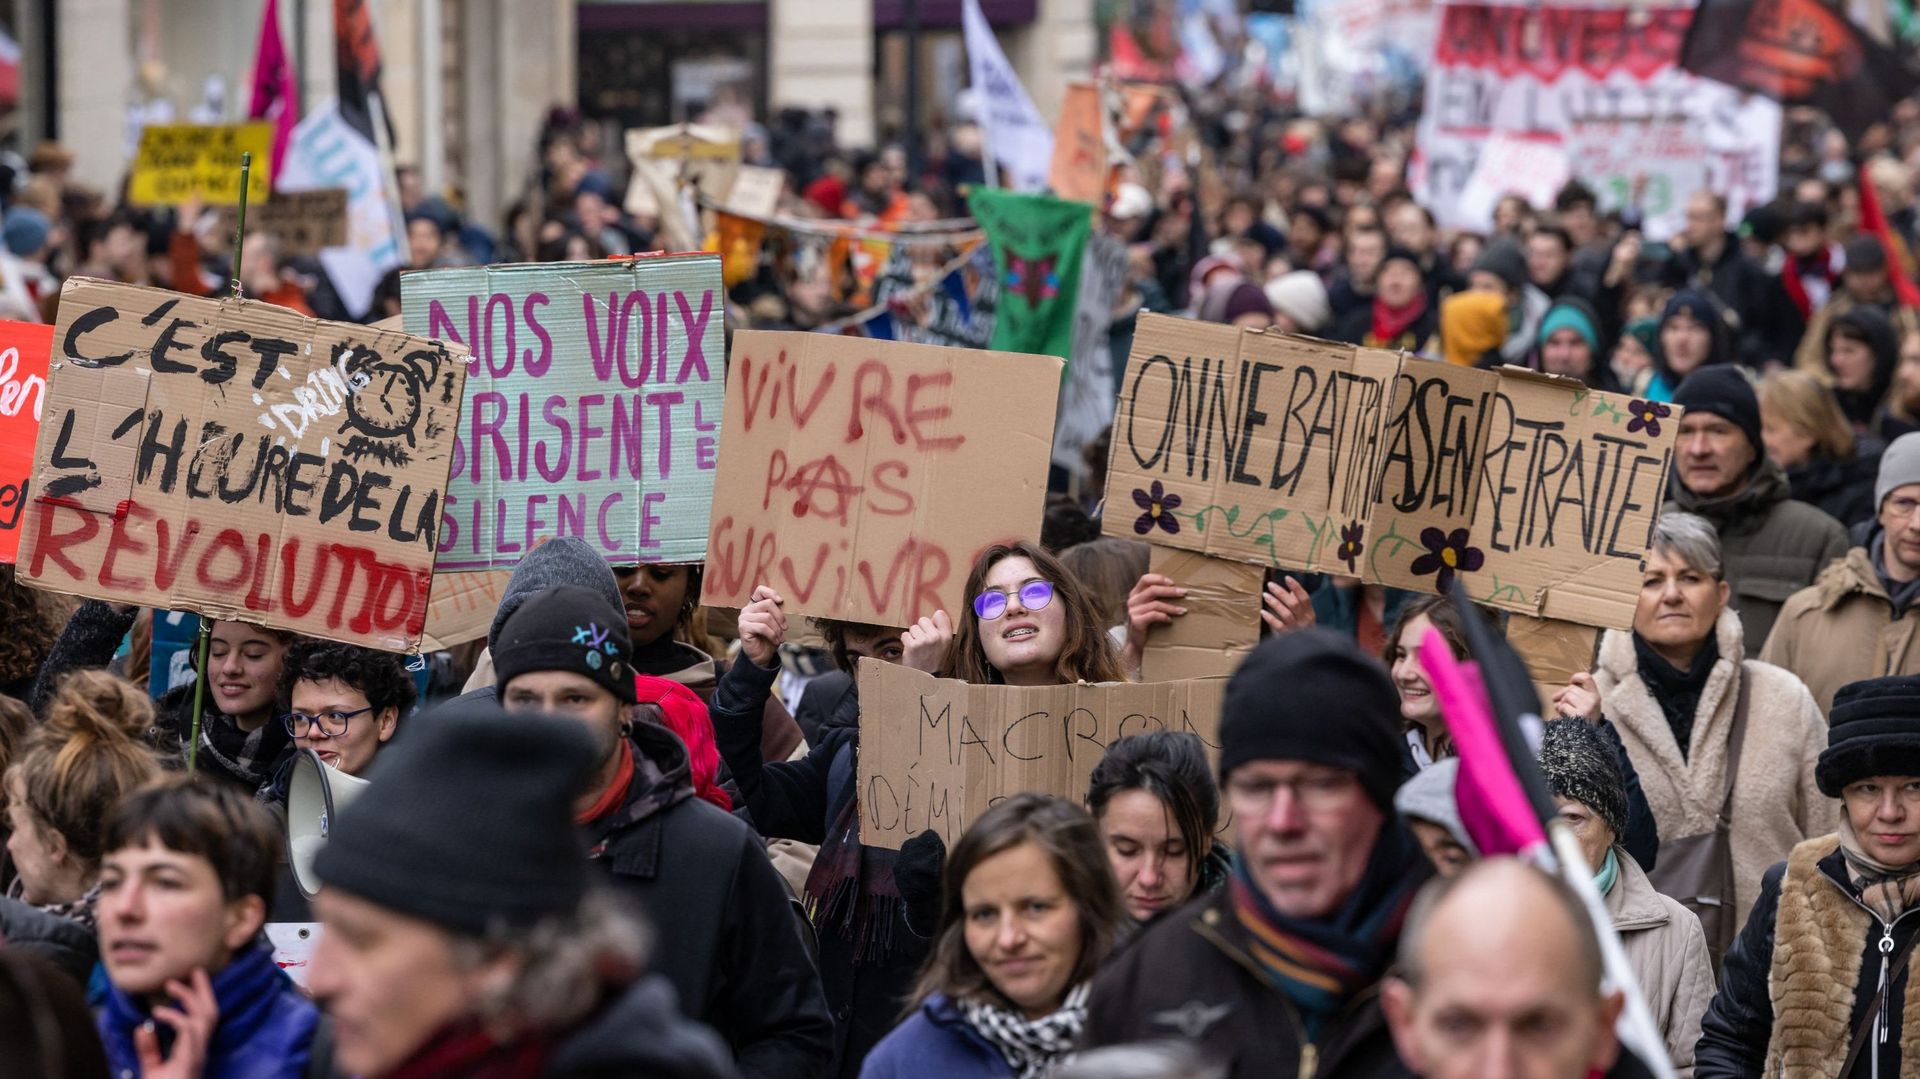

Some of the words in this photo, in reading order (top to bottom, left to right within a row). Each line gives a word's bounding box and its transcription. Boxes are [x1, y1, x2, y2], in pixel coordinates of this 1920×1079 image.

[63, 299, 298, 390] C'EST
[428, 292, 552, 378] NOS
[583, 289, 713, 388] VOIX
[704, 516, 1018, 626] SURViVR
